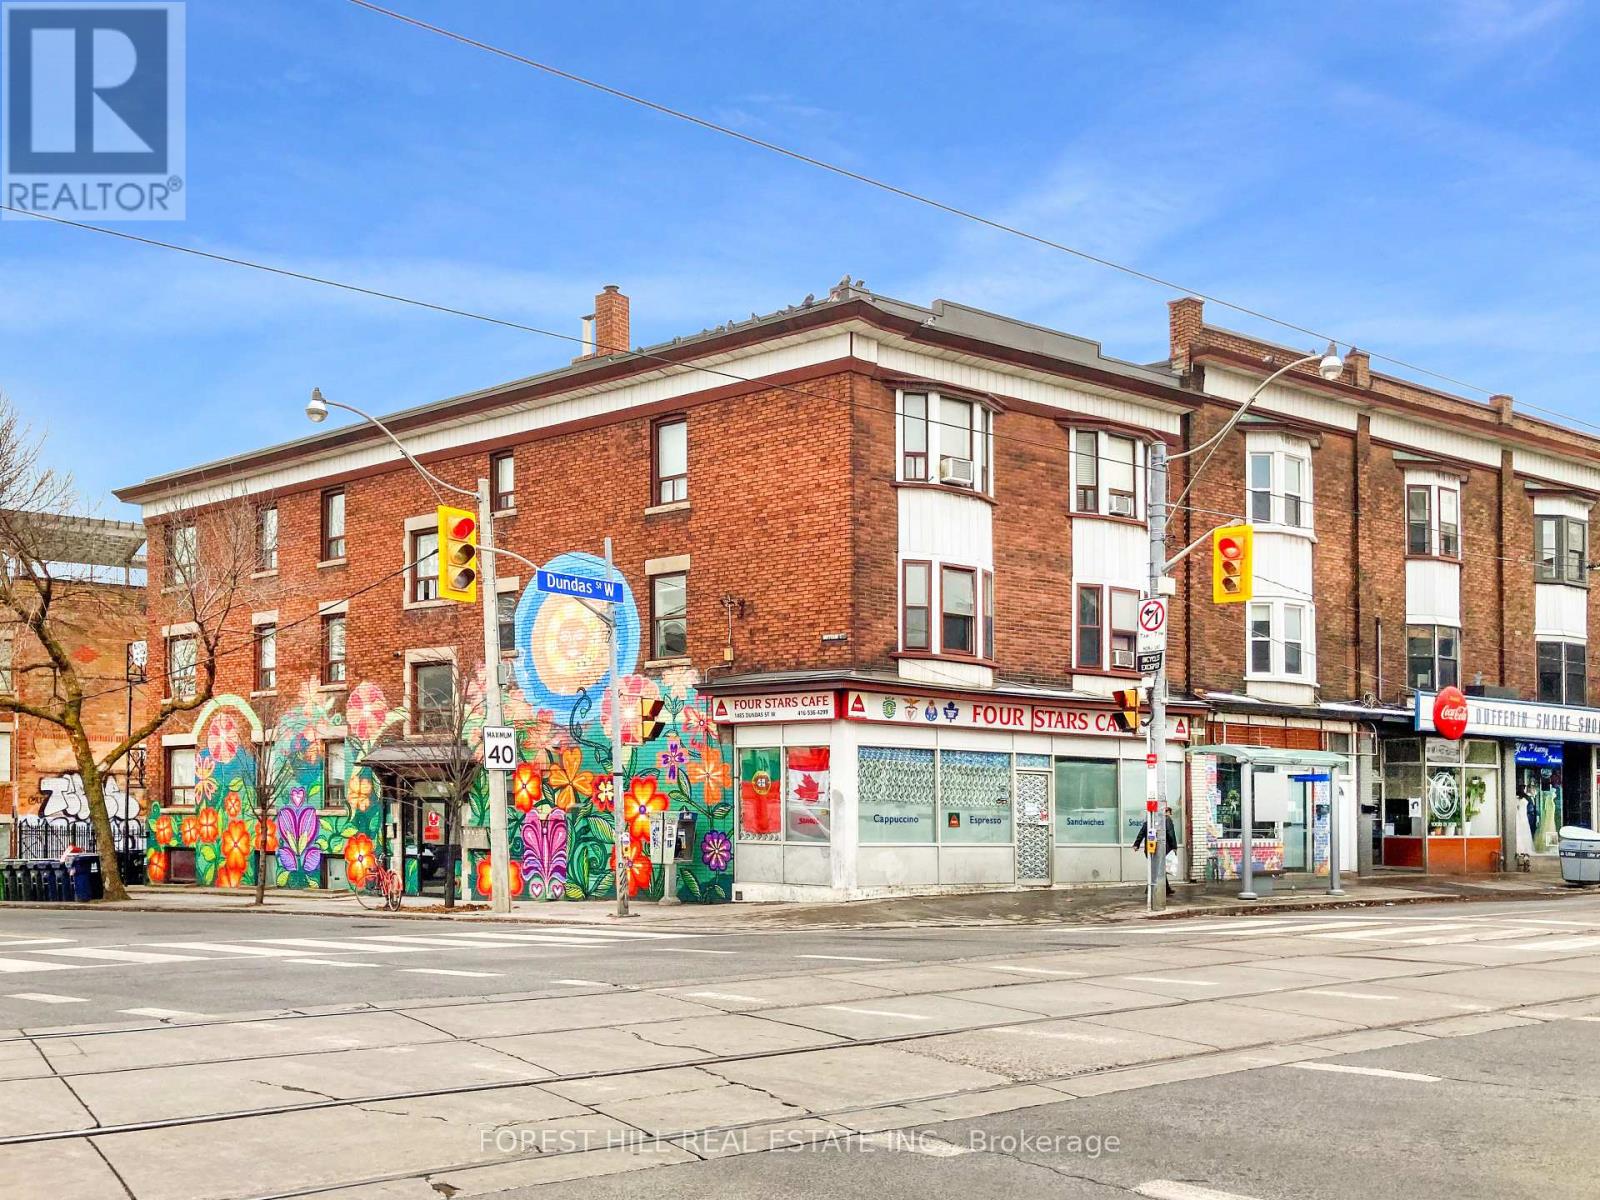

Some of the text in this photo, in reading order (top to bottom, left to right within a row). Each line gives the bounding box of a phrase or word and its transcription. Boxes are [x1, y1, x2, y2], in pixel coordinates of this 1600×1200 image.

[547, 573, 614, 597] Dundas St W
[734, 695, 829, 710] FOUR STARS CAFE
[745, 711, 764, 719] DUNDAS
[972, 704, 1118, 732] FOUR STARS CA
[1475, 708, 1600, 734] DUFFERIN SMOKE SHO
[486, 731, 512, 739] MAXIMUM
[488, 745, 514, 764] 40
[873, 814, 919, 825] Cappuccino
[969, 815, 1002, 826] Espresso
[1066, 816, 1105, 826] Sandwiches
